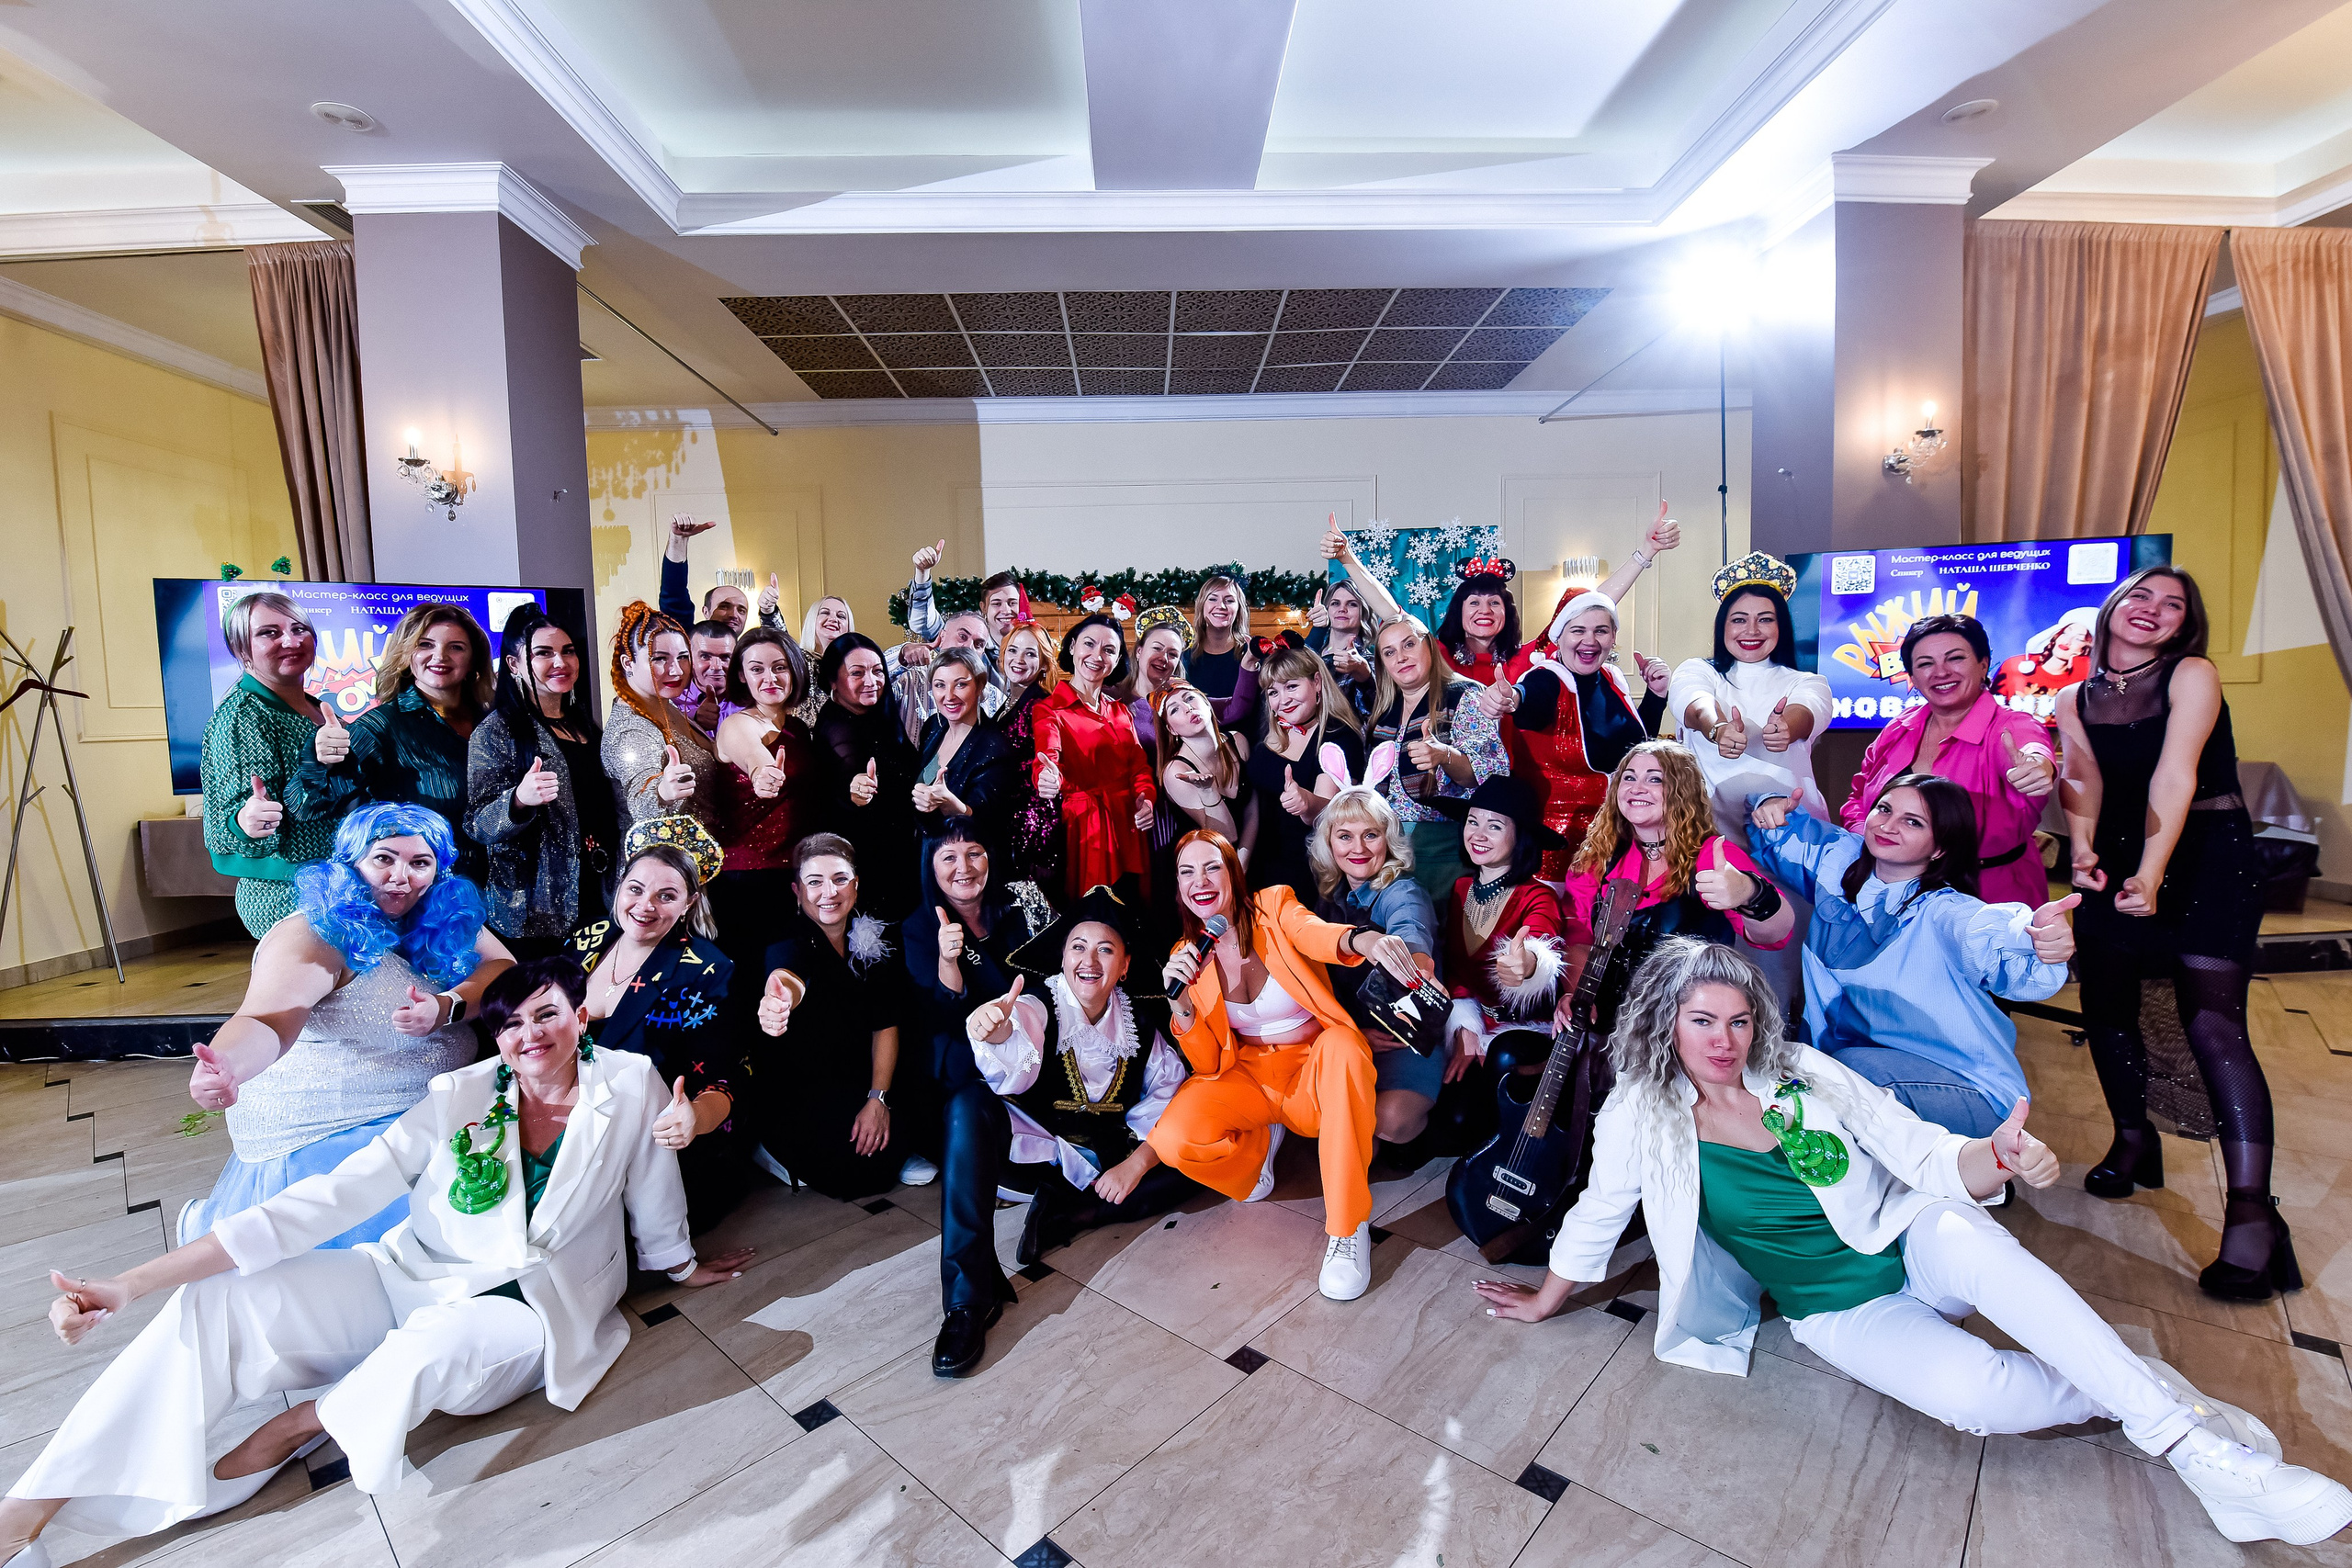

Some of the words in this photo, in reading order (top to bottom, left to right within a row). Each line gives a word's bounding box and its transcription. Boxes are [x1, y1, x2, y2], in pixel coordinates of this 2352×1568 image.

[1891, 551, 1974, 565] Мастер-класс
[1977, 550, 1996, 561] для
[2000, 548, 2051, 560] ведущих
[1890, 569, 1924, 579] Спикер
[1939, 565, 1986, 575] НАТАША
[1989, 561, 2051, 573] ШЕВЧЕНКО
[291, 589, 389, 602] Мастер-класс
[391, 593, 413, 603] для
[416, 592, 469, 603] ведущих
[350, 606, 404, 615] НАТАША
